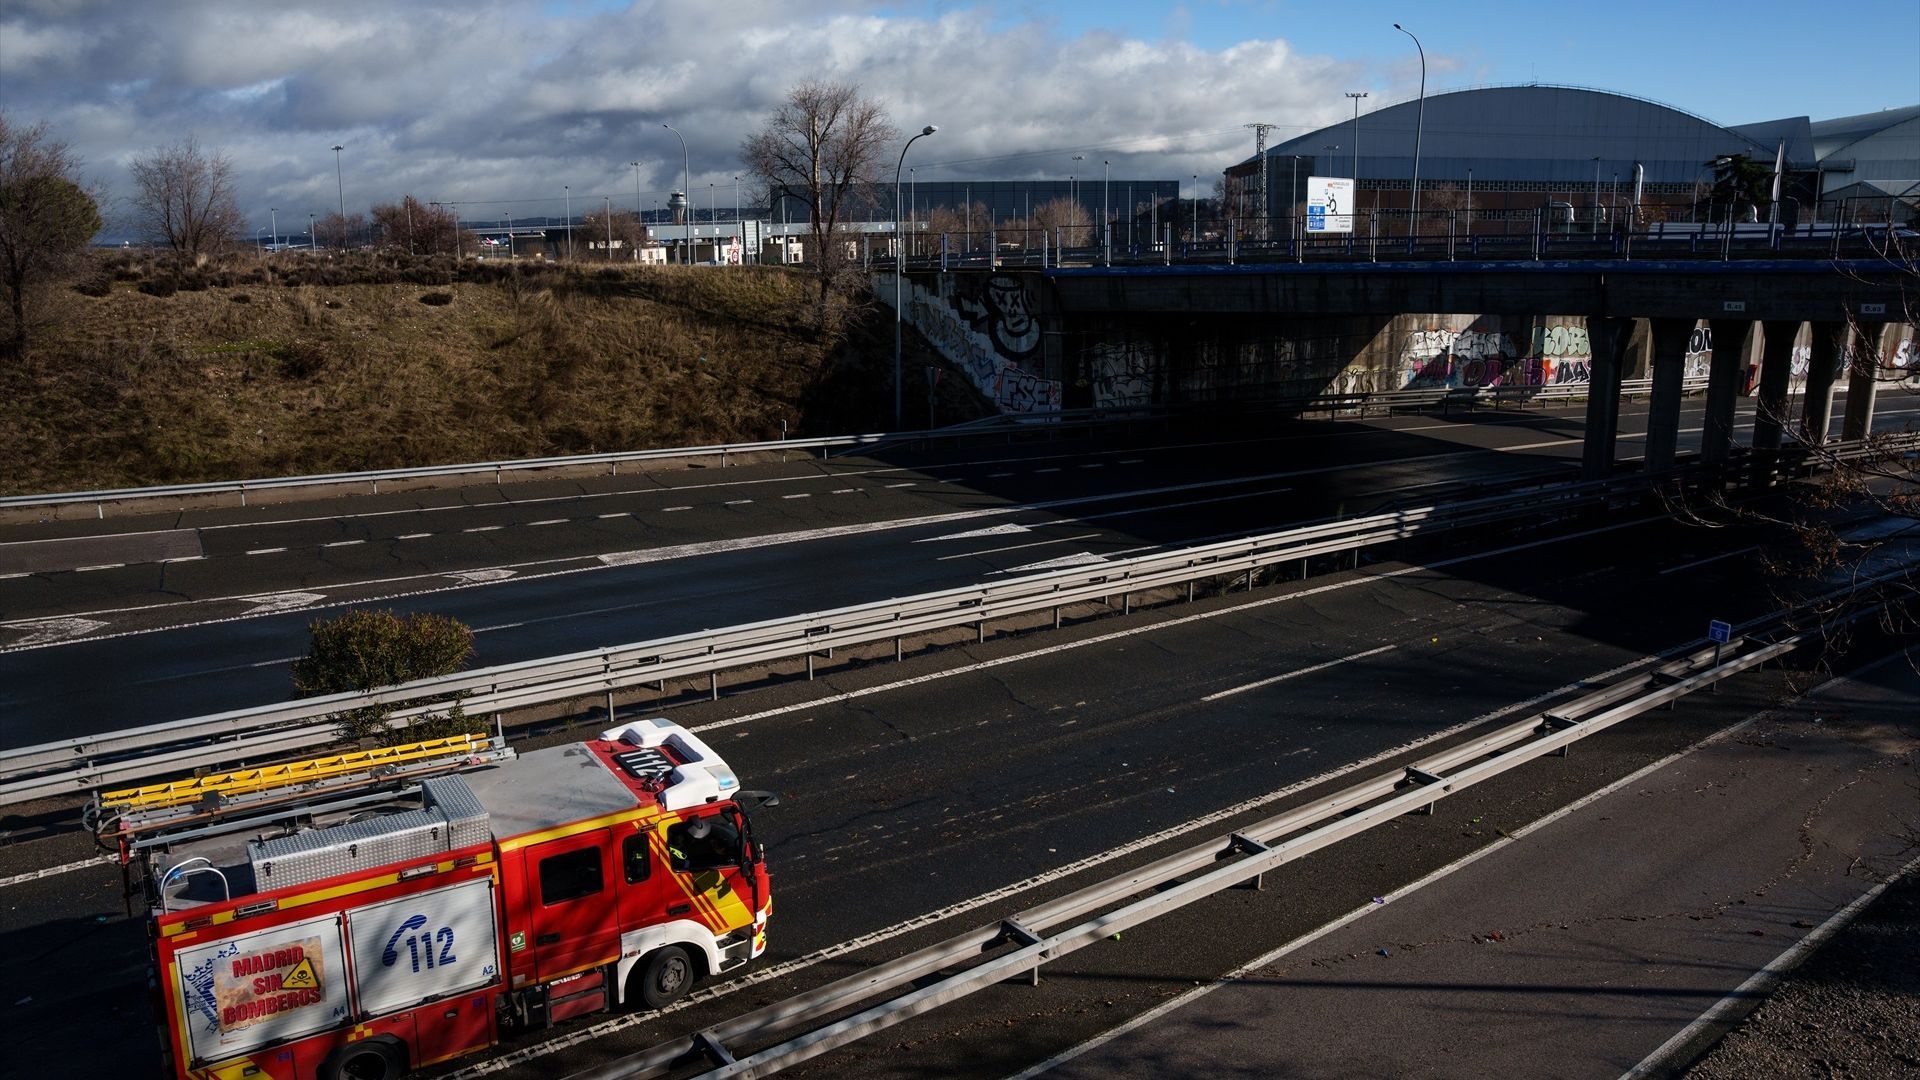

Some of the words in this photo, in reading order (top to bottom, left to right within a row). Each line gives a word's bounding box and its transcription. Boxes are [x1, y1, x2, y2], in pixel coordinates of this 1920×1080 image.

[1532, 325, 1591, 356] KOR
[232, 944, 305, 978] MADRID
[406, 926, 457, 973] 112
[252, 973, 283, 995] SIN
[482, 965, 494, 976] A2
[223, 988, 322, 1025] BOMBEROS
[332, 1005, 346, 1018] A4
